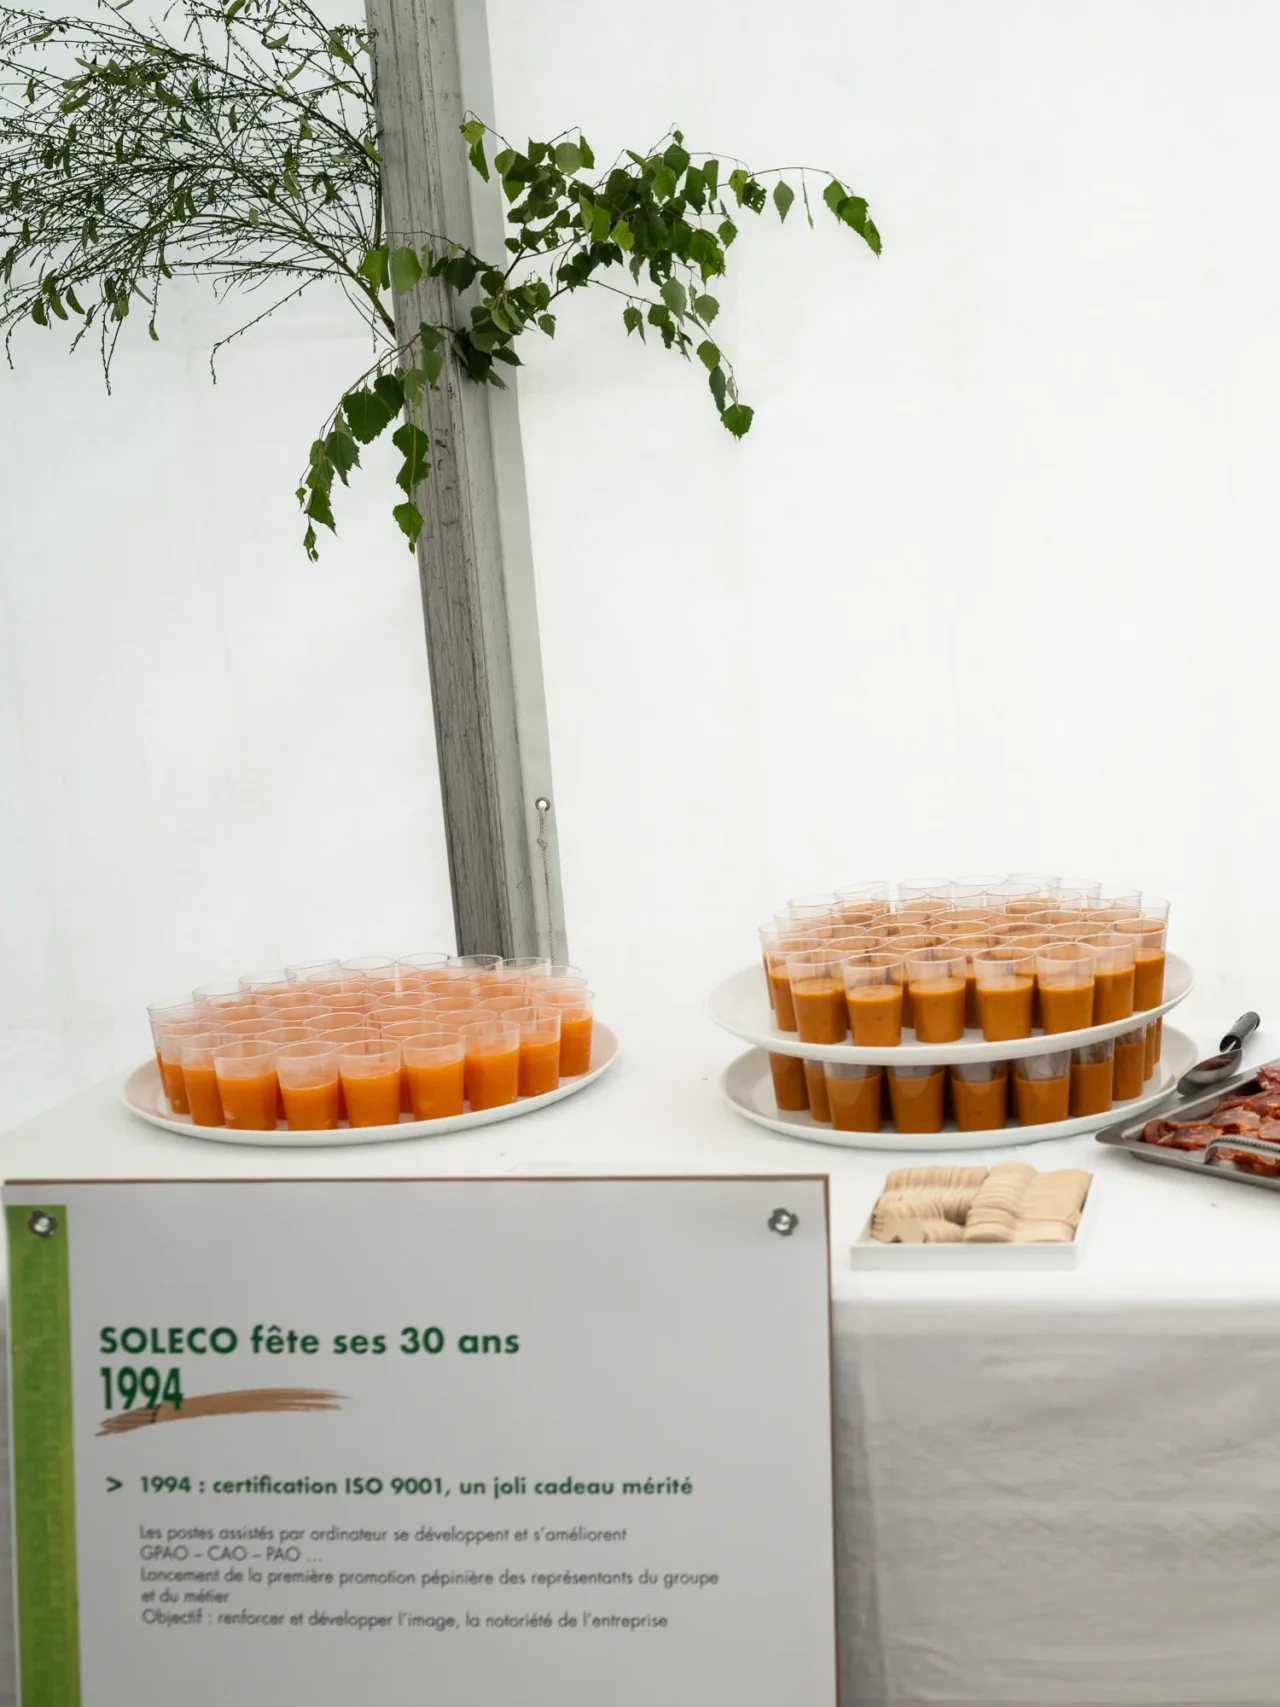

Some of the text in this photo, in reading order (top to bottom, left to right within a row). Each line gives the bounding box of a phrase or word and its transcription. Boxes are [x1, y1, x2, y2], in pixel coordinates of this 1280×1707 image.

[100, 1324, 519, 1355] SOLECO fête ses 30 ans
[100, 1367, 183, 1410] 1994
[141, 1476, 192, 1493] 1994
[213, 1475, 337, 1494] certification
[345, 1477, 383, 1495] ISO
[390, 1477, 450, 1497] 9001,
[459, 1482, 486, 1495] un
[494, 1476, 526, 1500] joli
[534, 1476, 614, 1495] cadeau
[622, 1477, 693, 1495] mérité
[139, 1524, 163, 1540] Les
[167, 1527, 214, 1543] postes
[219, 1526, 274, 1540] assistés
[279, 1530, 305, 1544] par
[310, 1525, 388, 1541] ordinateur
[394, 1531, 410, 1542] se
[414, 1525, 509, 1546] développent
[514, 1529, 528, 1542] et
[140, 1544, 189, 1561] GPAO
[207, 1545, 248, 1561] CAO
[266, 1546, 301, 1562] PAO
[141, 1566, 719, 1589] Lancement de la première promotion pépinière des représentants du groupe
[141, 1588, 230, 1604] et du métier
[141, 1608, 203, 1628] Objectif
[218, 1608, 284, 1625] renforcer
[290, 1613, 304, 1625] et
[308, 1610, 393, 1631] développer
[466, 1612, 480, 1628] la
[486, 1613, 552, 1628] notoriété
[558, 1612, 577, 1628] de
